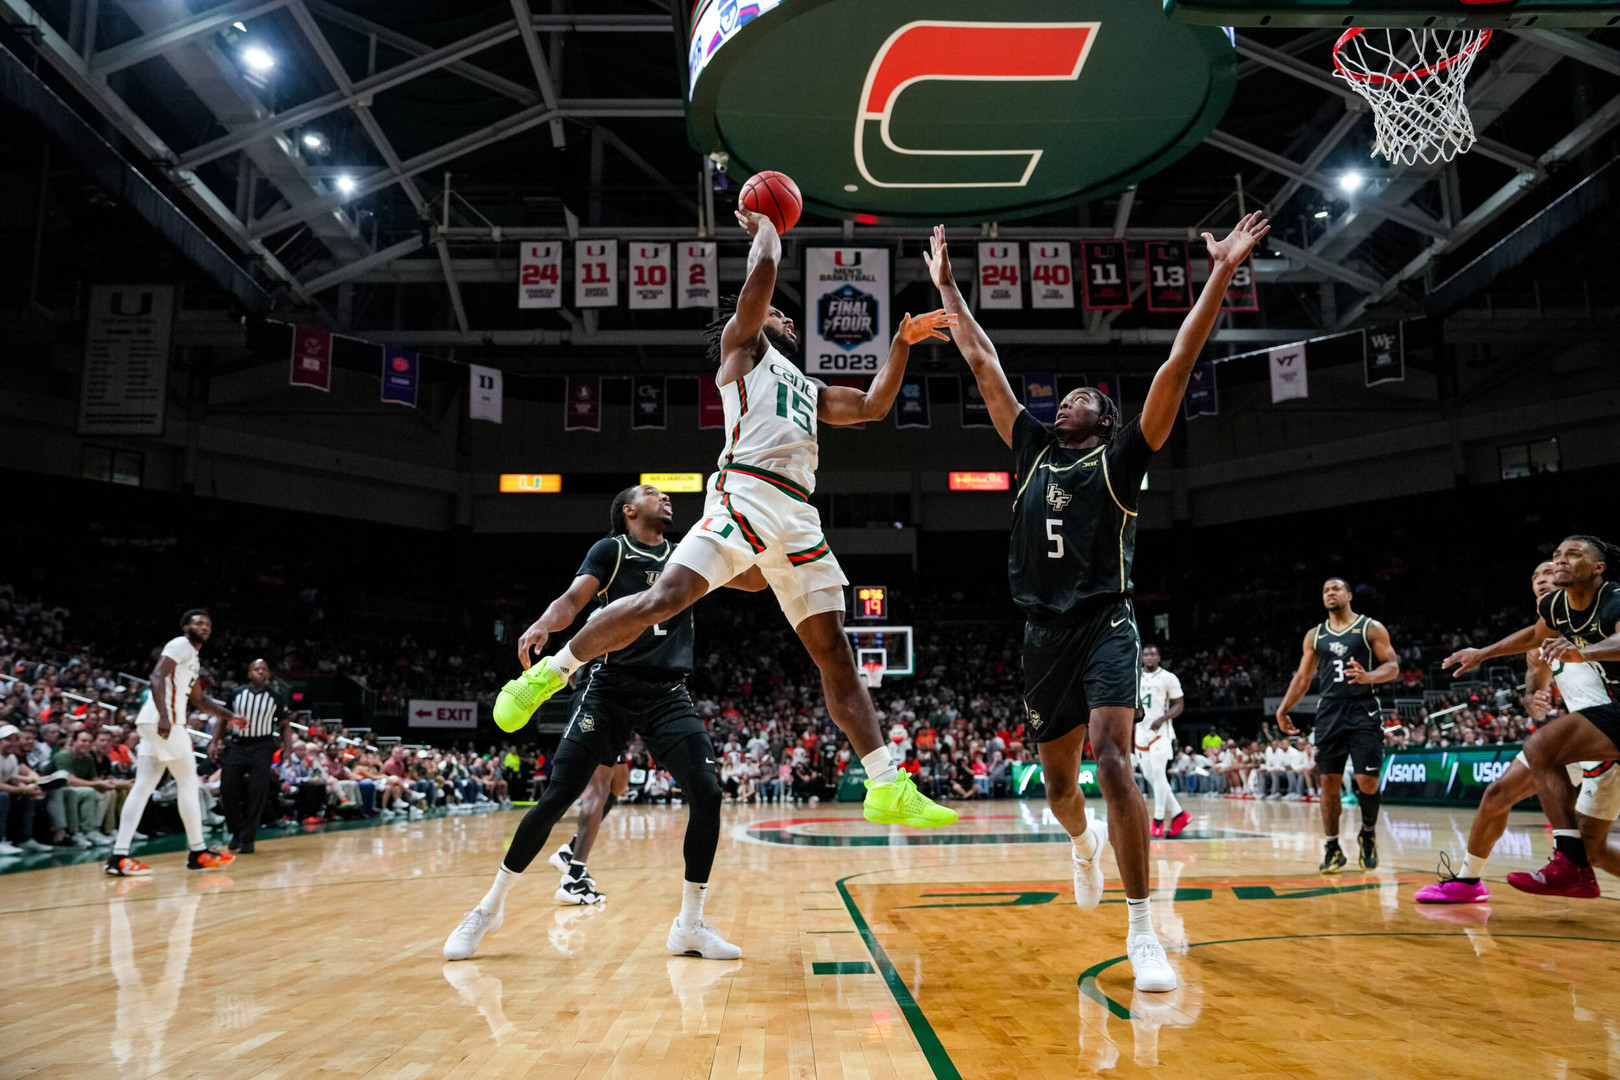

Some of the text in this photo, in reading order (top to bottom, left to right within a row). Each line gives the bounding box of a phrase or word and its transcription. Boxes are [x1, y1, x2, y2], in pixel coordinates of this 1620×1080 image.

[835, 251, 861, 267] U
[522, 264, 559, 285] 24
[582, 263, 611, 284] 11
[634, 265, 668, 286] 10
[690, 264, 706, 285] 2
[819, 274, 877, 282] BASKETBALL
[834, 267, 862, 275] MEN'S
[982, 265, 1018, 286] 24
[1033, 265, 1070, 286] 40
[1090, 263, 1122, 285] 11
[1152, 265, 1185, 287] 13
[1229, 266, 1251, 286] 3
[828, 300, 869, 317] FINAL
[831, 315, 873, 334] FOUR
[819, 354, 877, 371] 2023
[1277, 354, 1298, 367] VT
[776, 381, 814, 436] 15
[1046, 483, 1073, 511] UCF
[1046, 519, 1064, 558] 5
[864, 599, 882, 616] 19
[1332, 659, 1344, 683] 3
[1142, 693, 1152, 709] 4
[437, 708, 473, 720] EXIT
